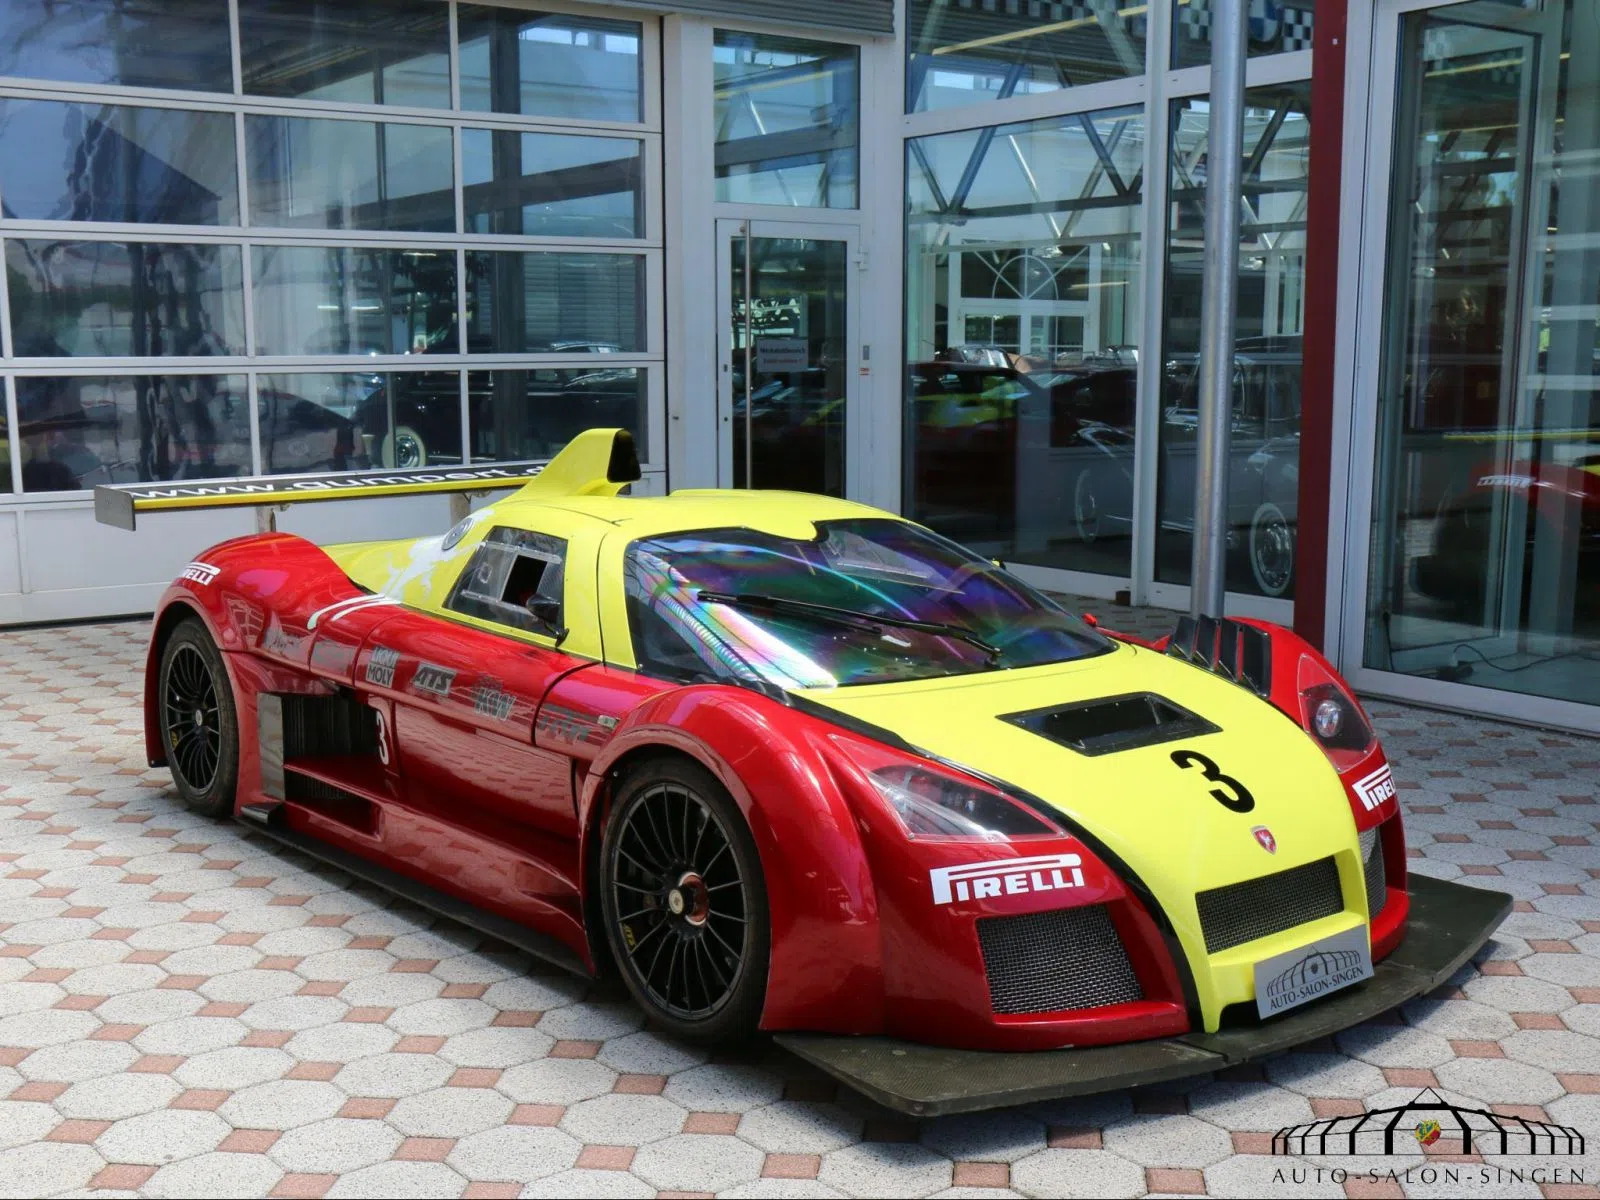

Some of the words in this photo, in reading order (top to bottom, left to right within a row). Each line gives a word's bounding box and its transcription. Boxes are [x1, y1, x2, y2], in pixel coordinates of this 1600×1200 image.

[367, 664, 394, 687] MOLY
[376, 711, 389, 765] 3
[1170, 750, 1255, 813] 3
[929, 853, 1085, 905] PIRELLI
[1270, 965, 1364, 1011] AUTO-SALON-SINGEN
